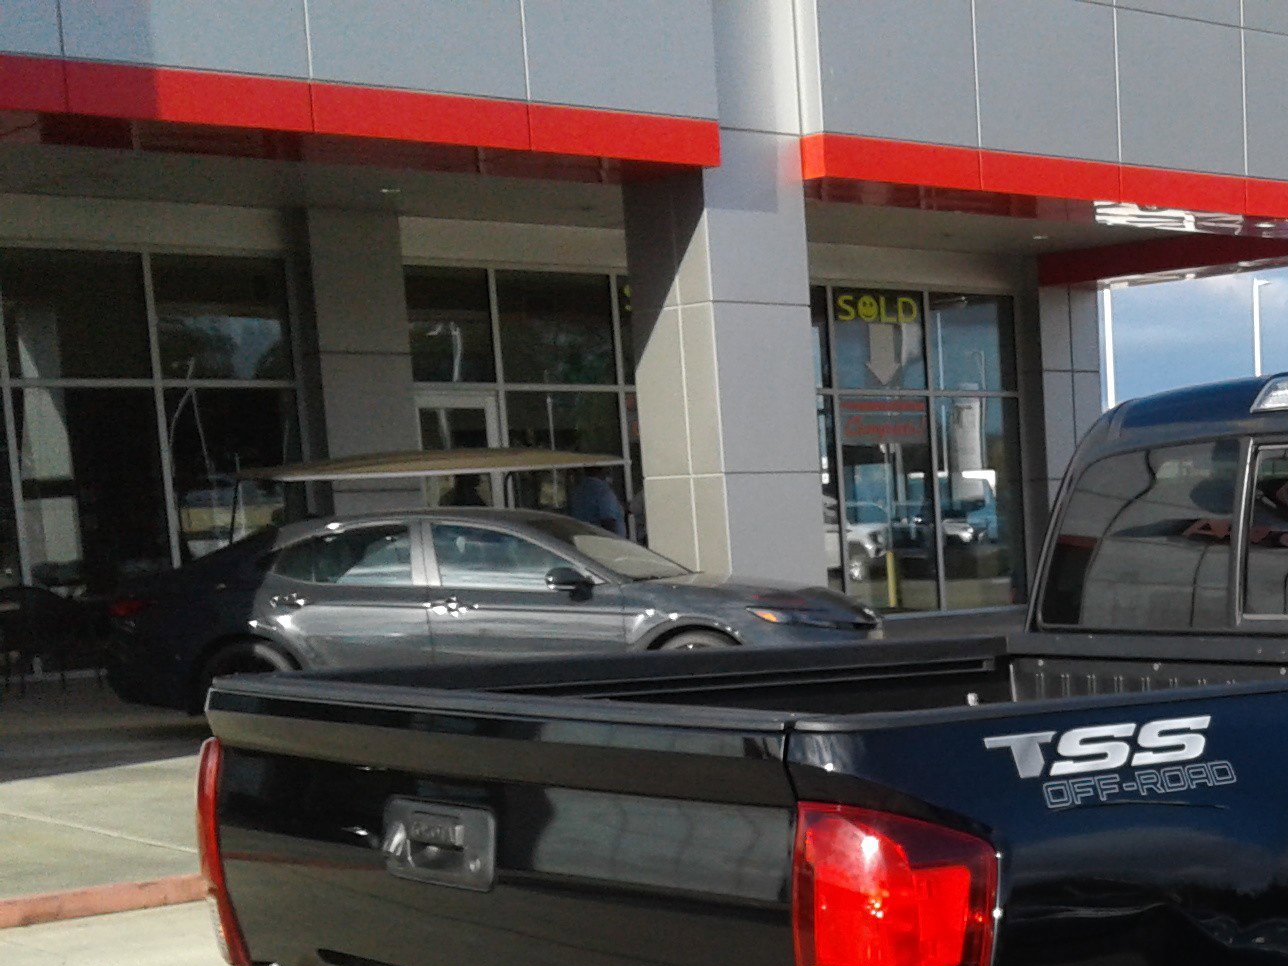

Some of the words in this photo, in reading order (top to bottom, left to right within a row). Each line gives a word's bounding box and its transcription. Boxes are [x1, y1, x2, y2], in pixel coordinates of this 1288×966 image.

[837, 295, 918, 323] SOLD
[983, 715, 1212, 779] TSS
[1042, 761, 1238, 809] OFF-ROAD
